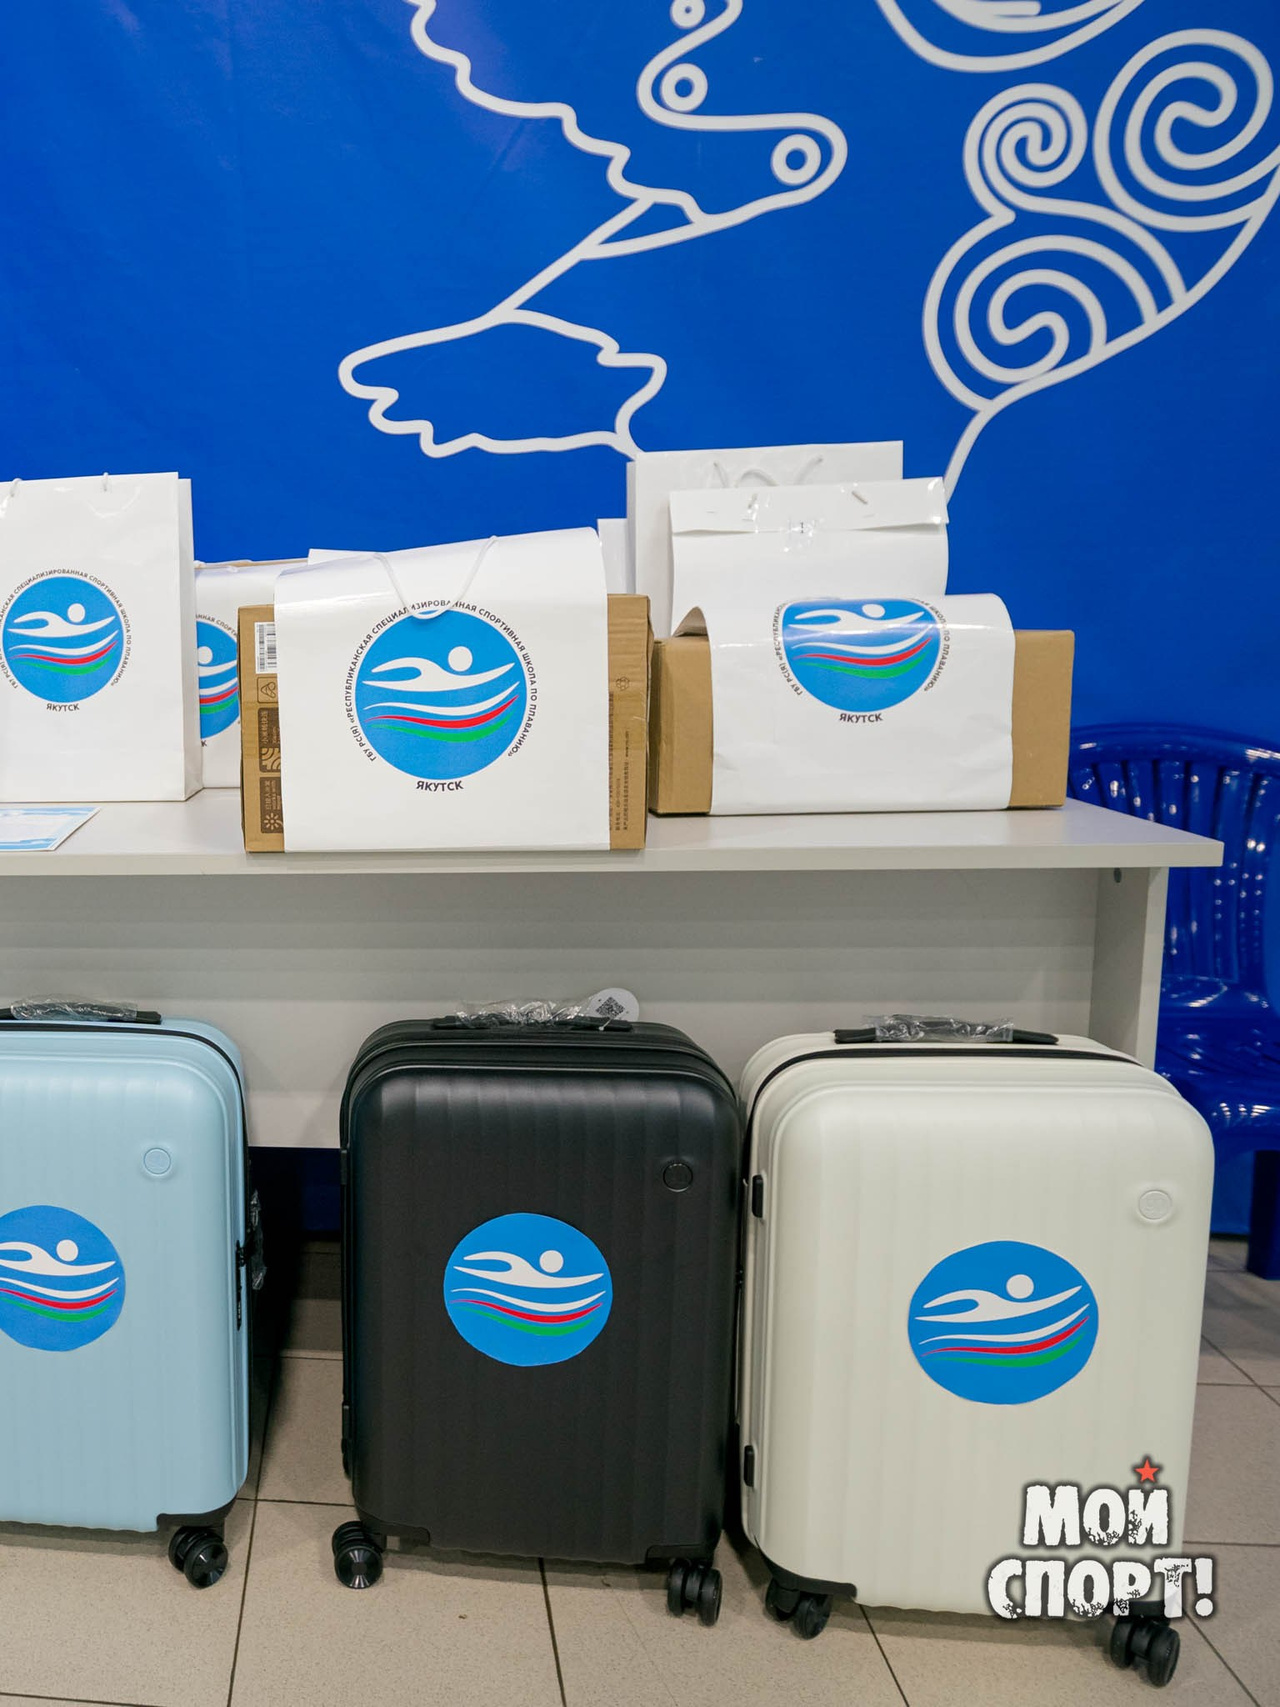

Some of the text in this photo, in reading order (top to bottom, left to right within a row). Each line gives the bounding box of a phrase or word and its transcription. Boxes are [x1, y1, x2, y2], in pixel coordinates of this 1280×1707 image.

[13, 568, 88, 594] СПЕЦИАЛИЗИРОВАННАЯ
[89, 575, 123, 608] СПОРТИВНАЯ
[120, 608, 131, 634] ШКОЛА
[478, 608, 526, 652] СПОРТИВНАЯ
[126, 634, 132, 645] ПО
[944, 630, 950, 642] ПО
[110, 646, 132, 686] ПЛАВАНИЮ»
[521, 652, 537, 687] ШКОЛА
[778, 662, 792, 684] РС(Я)
[924, 644, 950, 692] ПЛАВАНИЮ»
[344, 634, 374, 724] «РЕСПУБЛИКАНСКАЯ
[790, 684, 804, 696] ГБУ
[530, 687, 538, 702] ПО
[46, 702, 80, 712] ЯКУТСК
[839, 712, 884, 724] ЯКУТСК
[350, 724, 366, 748] РС(Я)
[506, 704, 537, 758] ПЛАВАНИЮ»
[362, 748, 377, 762] ГБУ
[416, 780, 464, 792] ЯКУТСК
